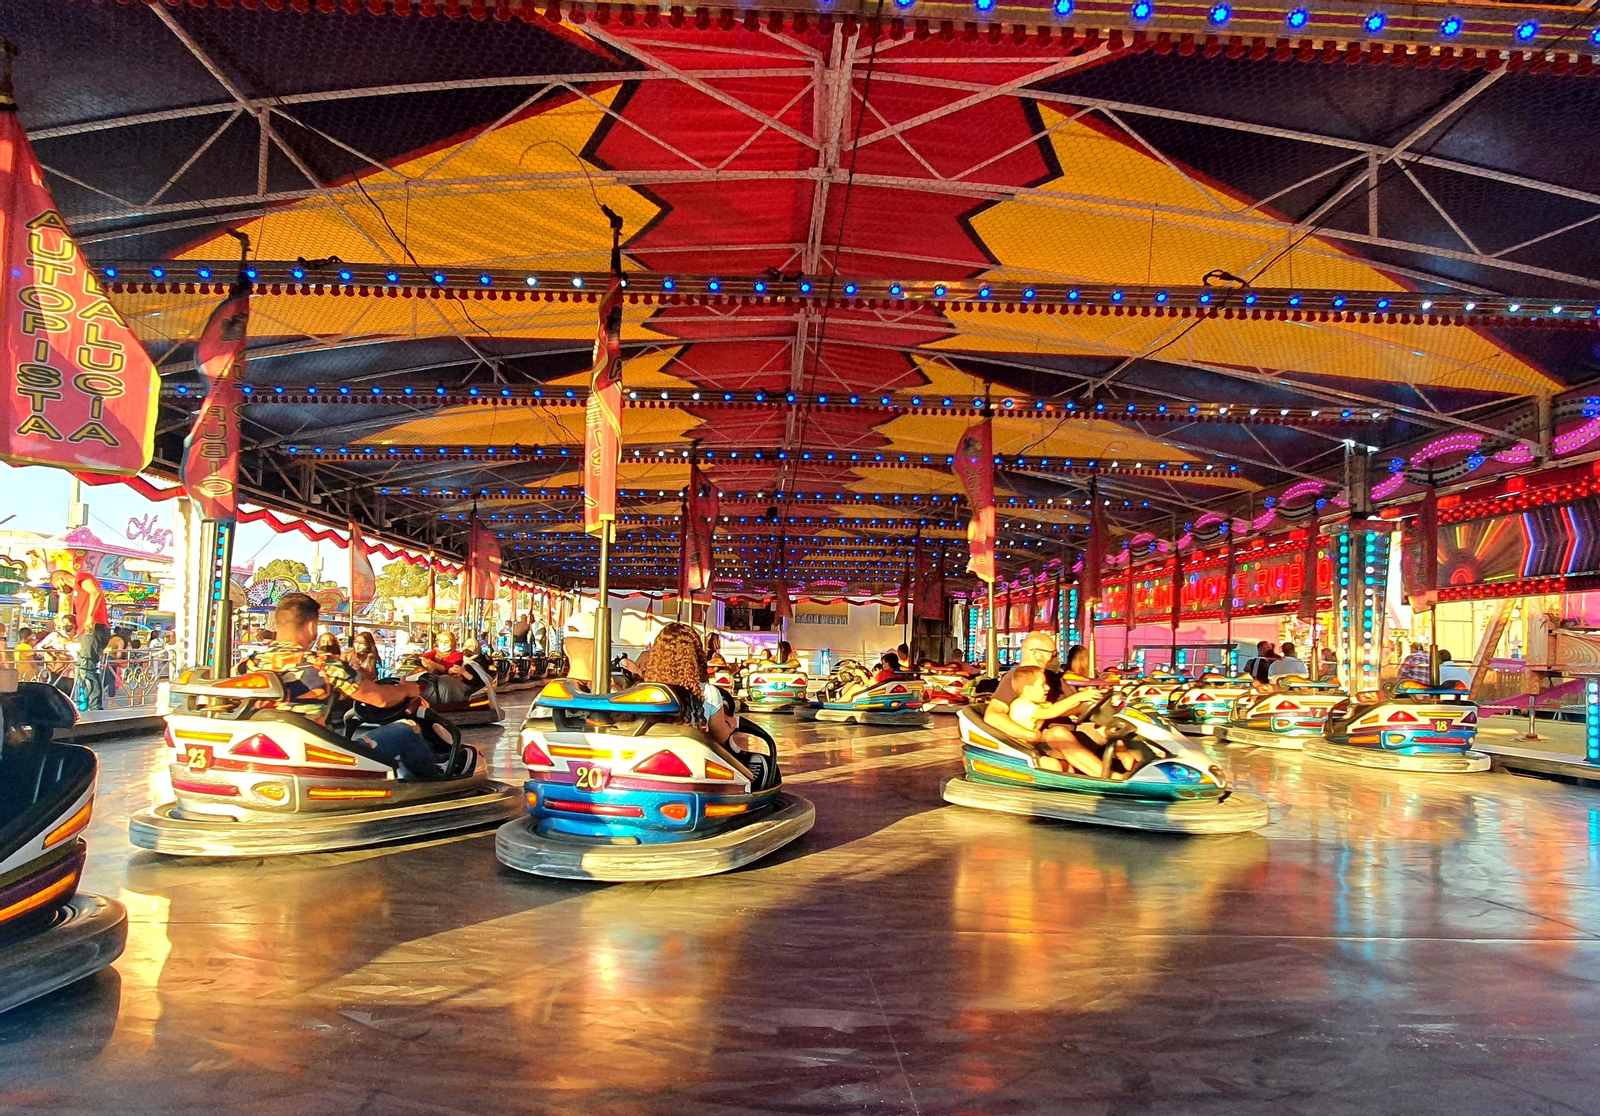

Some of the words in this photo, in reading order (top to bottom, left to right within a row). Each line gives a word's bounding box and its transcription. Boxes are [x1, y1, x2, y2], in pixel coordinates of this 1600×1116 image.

[16, 208, 76, 442] AUTOPISTA
[1152, 573, 1227, 608] ANALUCIA
[1236, 557, 1333, 600] E.RUBO
[1314, 708, 1322, 718] 7
[1435, 720, 1448, 732] 18
[188, 748, 206, 768] 23
[576, 766, 603, 789] 20
